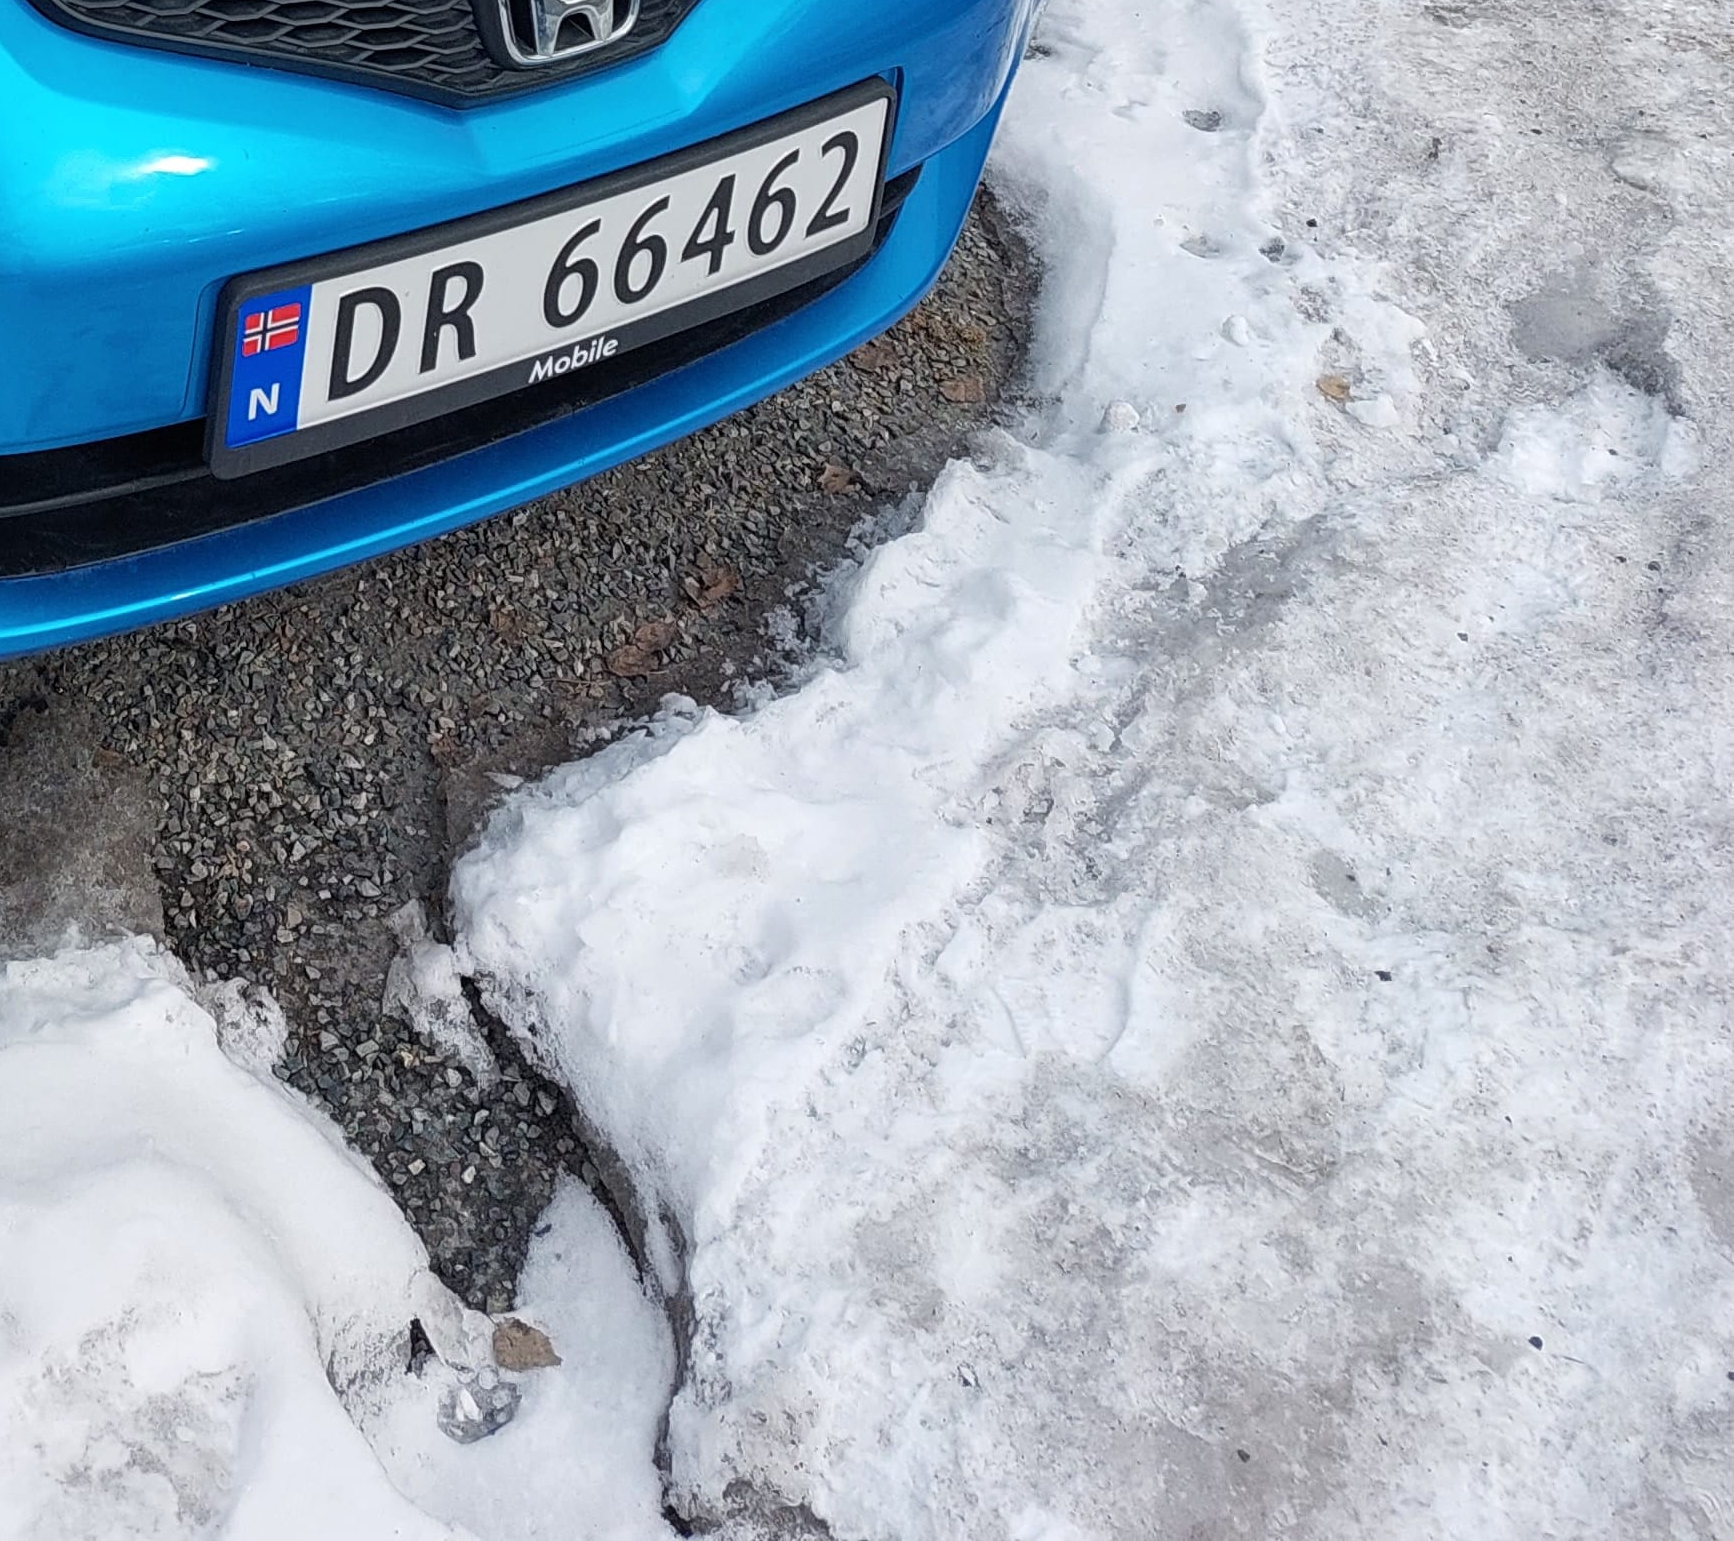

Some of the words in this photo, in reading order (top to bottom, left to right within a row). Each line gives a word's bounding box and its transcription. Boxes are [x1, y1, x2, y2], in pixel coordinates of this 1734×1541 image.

[327, 260, 485, 402] DR
[542, 130, 861, 329] 66462
[528, 335, 619, 384] Mobile
[248, 382, 281, 421] N
